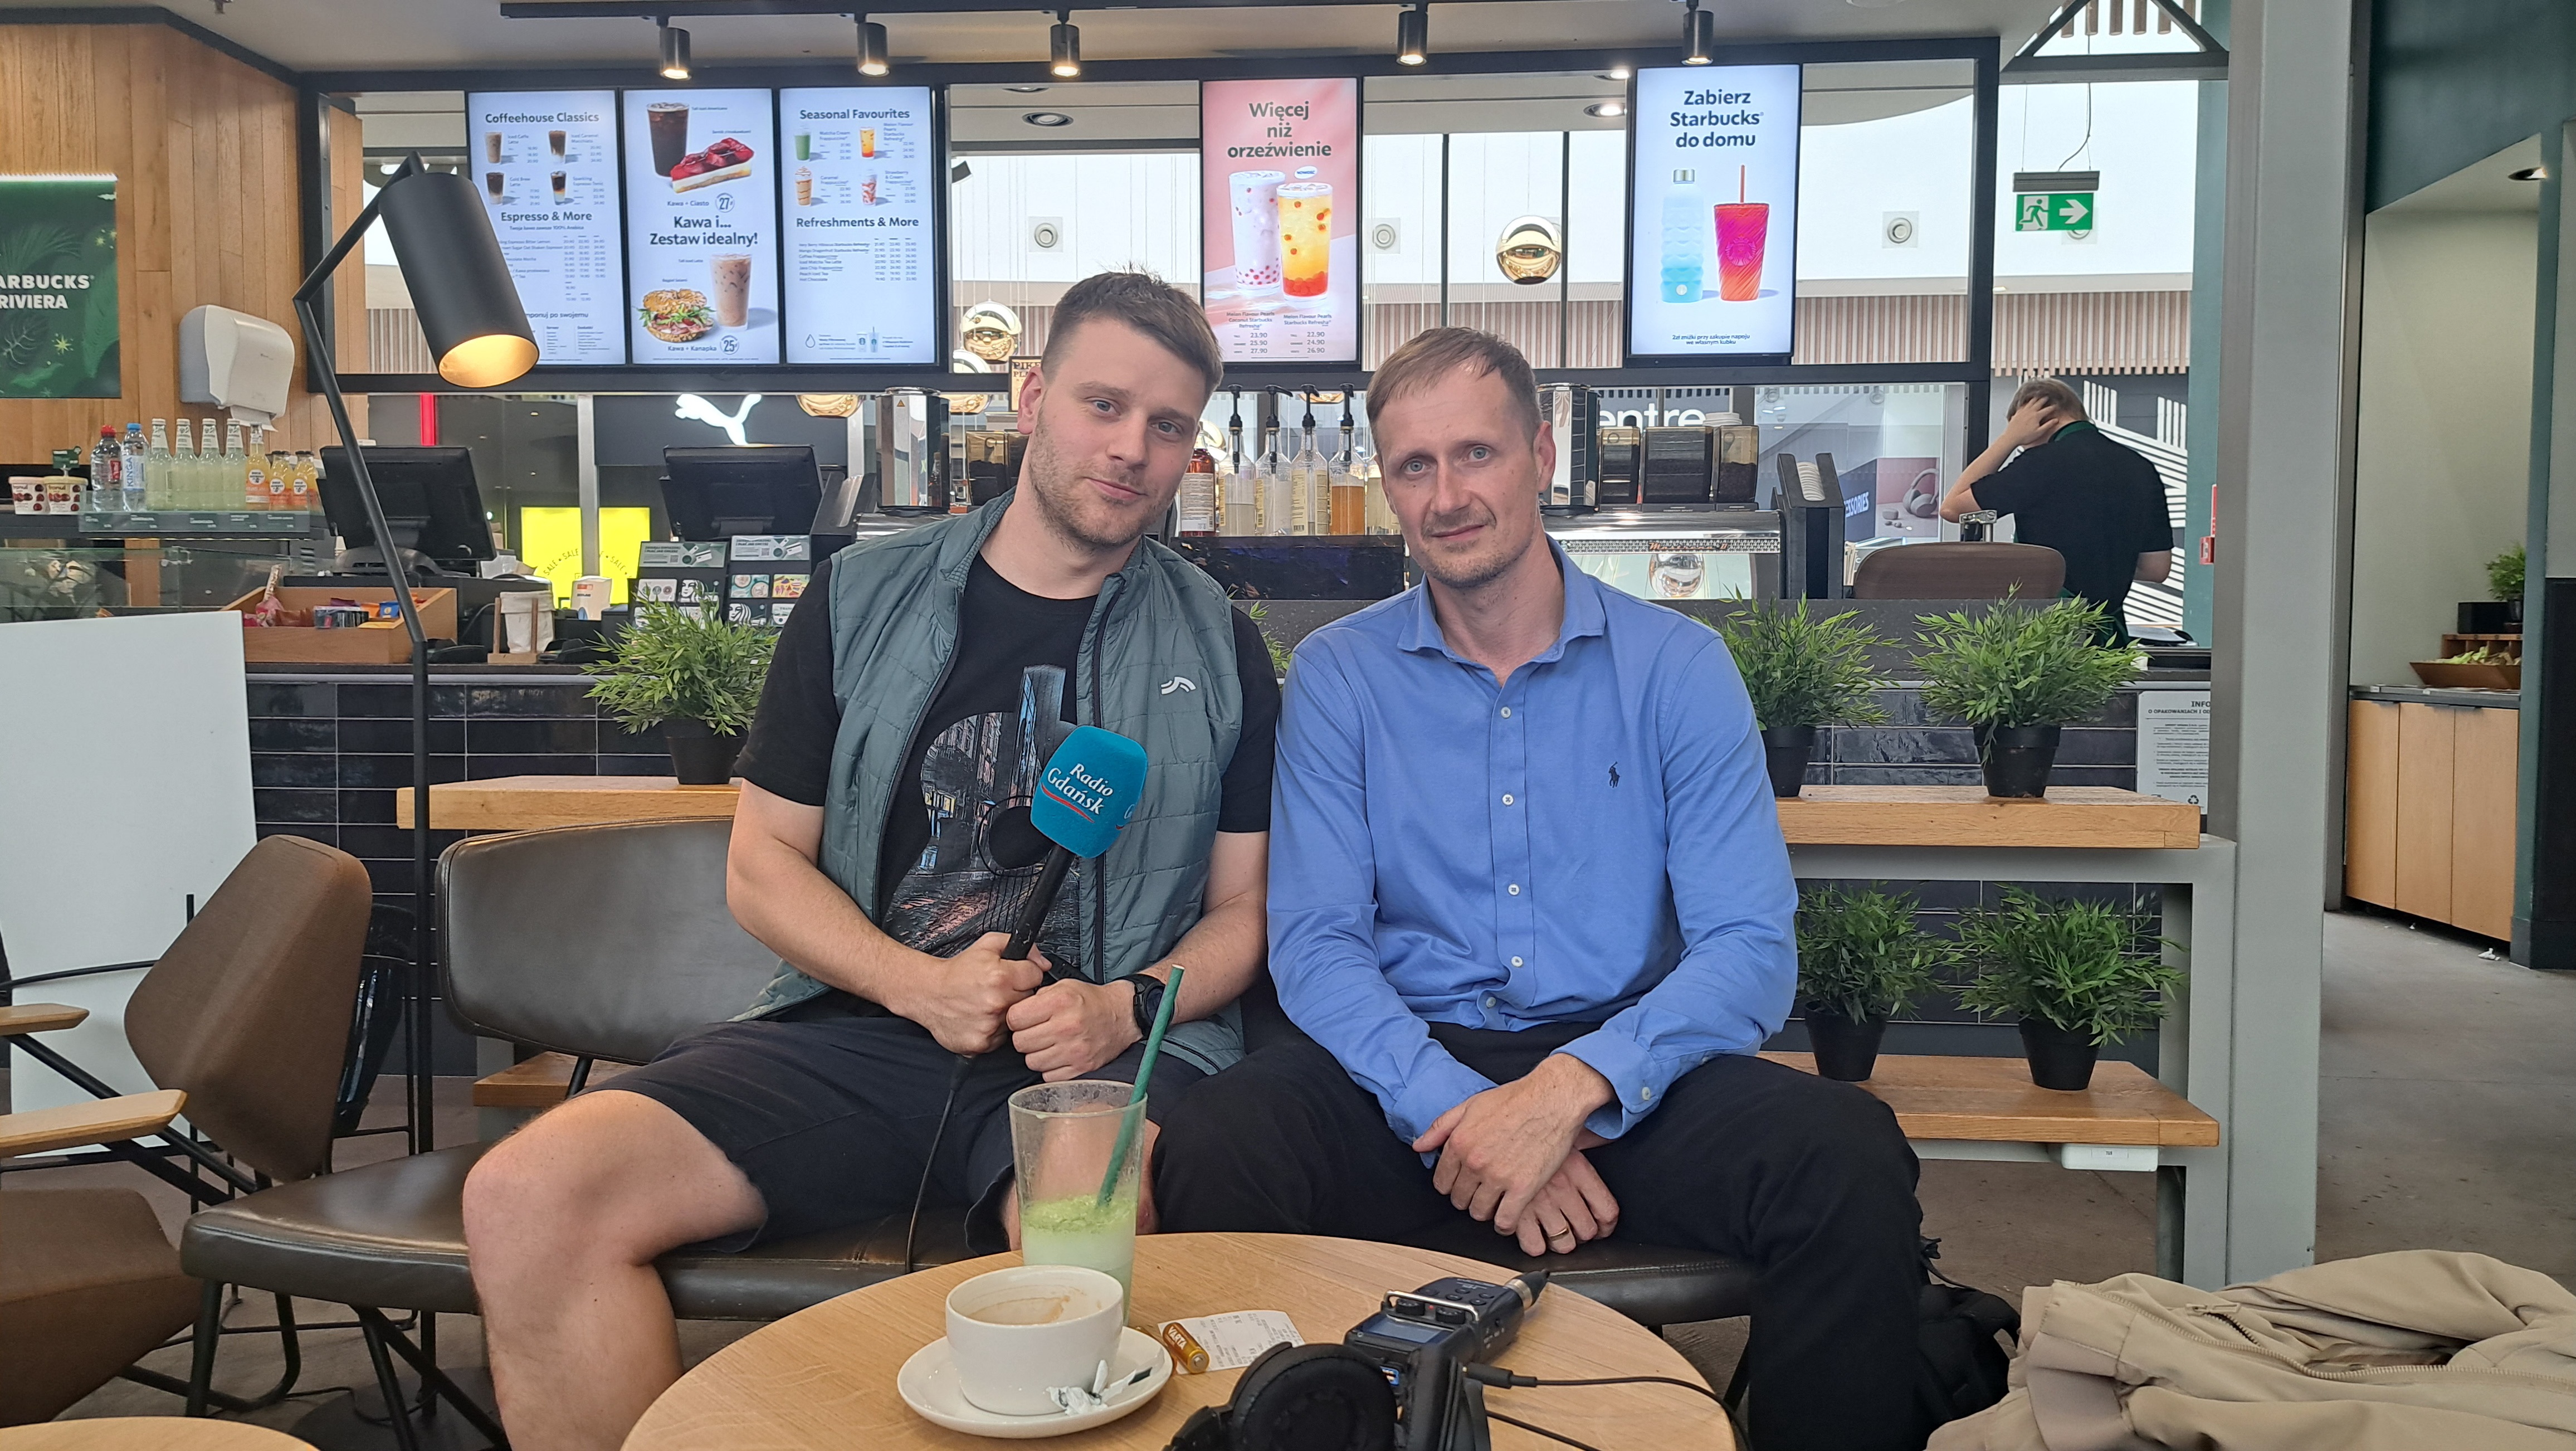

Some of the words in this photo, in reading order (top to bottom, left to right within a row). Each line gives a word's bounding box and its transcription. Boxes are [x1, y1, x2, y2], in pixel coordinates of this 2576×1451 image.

[1684, 89, 1751, 105] Zabierz
[485, 113, 554, 123] Coffeehouse
[557, 112, 599, 122] Classics
[800, 109, 850, 119] Seasonal
[852, 108, 910, 119] Favourites
[1248, 101, 1309, 121] Więcej
[1267, 122, 1292, 138] niż
[1676, 132, 1699, 148] do
[1703, 132, 1755, 147] domu
[1227, 141, 1332, 158] orzeźwienie
[719, 197, 730, 210] 27
[501, 212, 549, 223] Espresso
[552, 212, 560, 221] &
[563, 212, 592, 221] More
[674, 216, 712, 228] Kawa
[716, 215, 731, 228] i...
[797, 217, 875, 227] Refreshments
[877, 217, 886, 227] &
[889, 217, 919, 227] More
[650, 233, 700, 245] Zestaw
[703, 232, 758, 247] idealny!
[0, 294, 69, 309] RIVIERA
[724, 340, 734, 352] 25
[1599, 403, 1706, 433] entre
[562, 548, 579, 560] SALE
[543, 559, 558, 576] SALE
[610, 556, 626, 571] SALE
[1069, 763, 1113, 796] Radio
[1047, 767, 1104, 815] Gdańsk
[1167, 1326, 1187, 1350] VARTA
